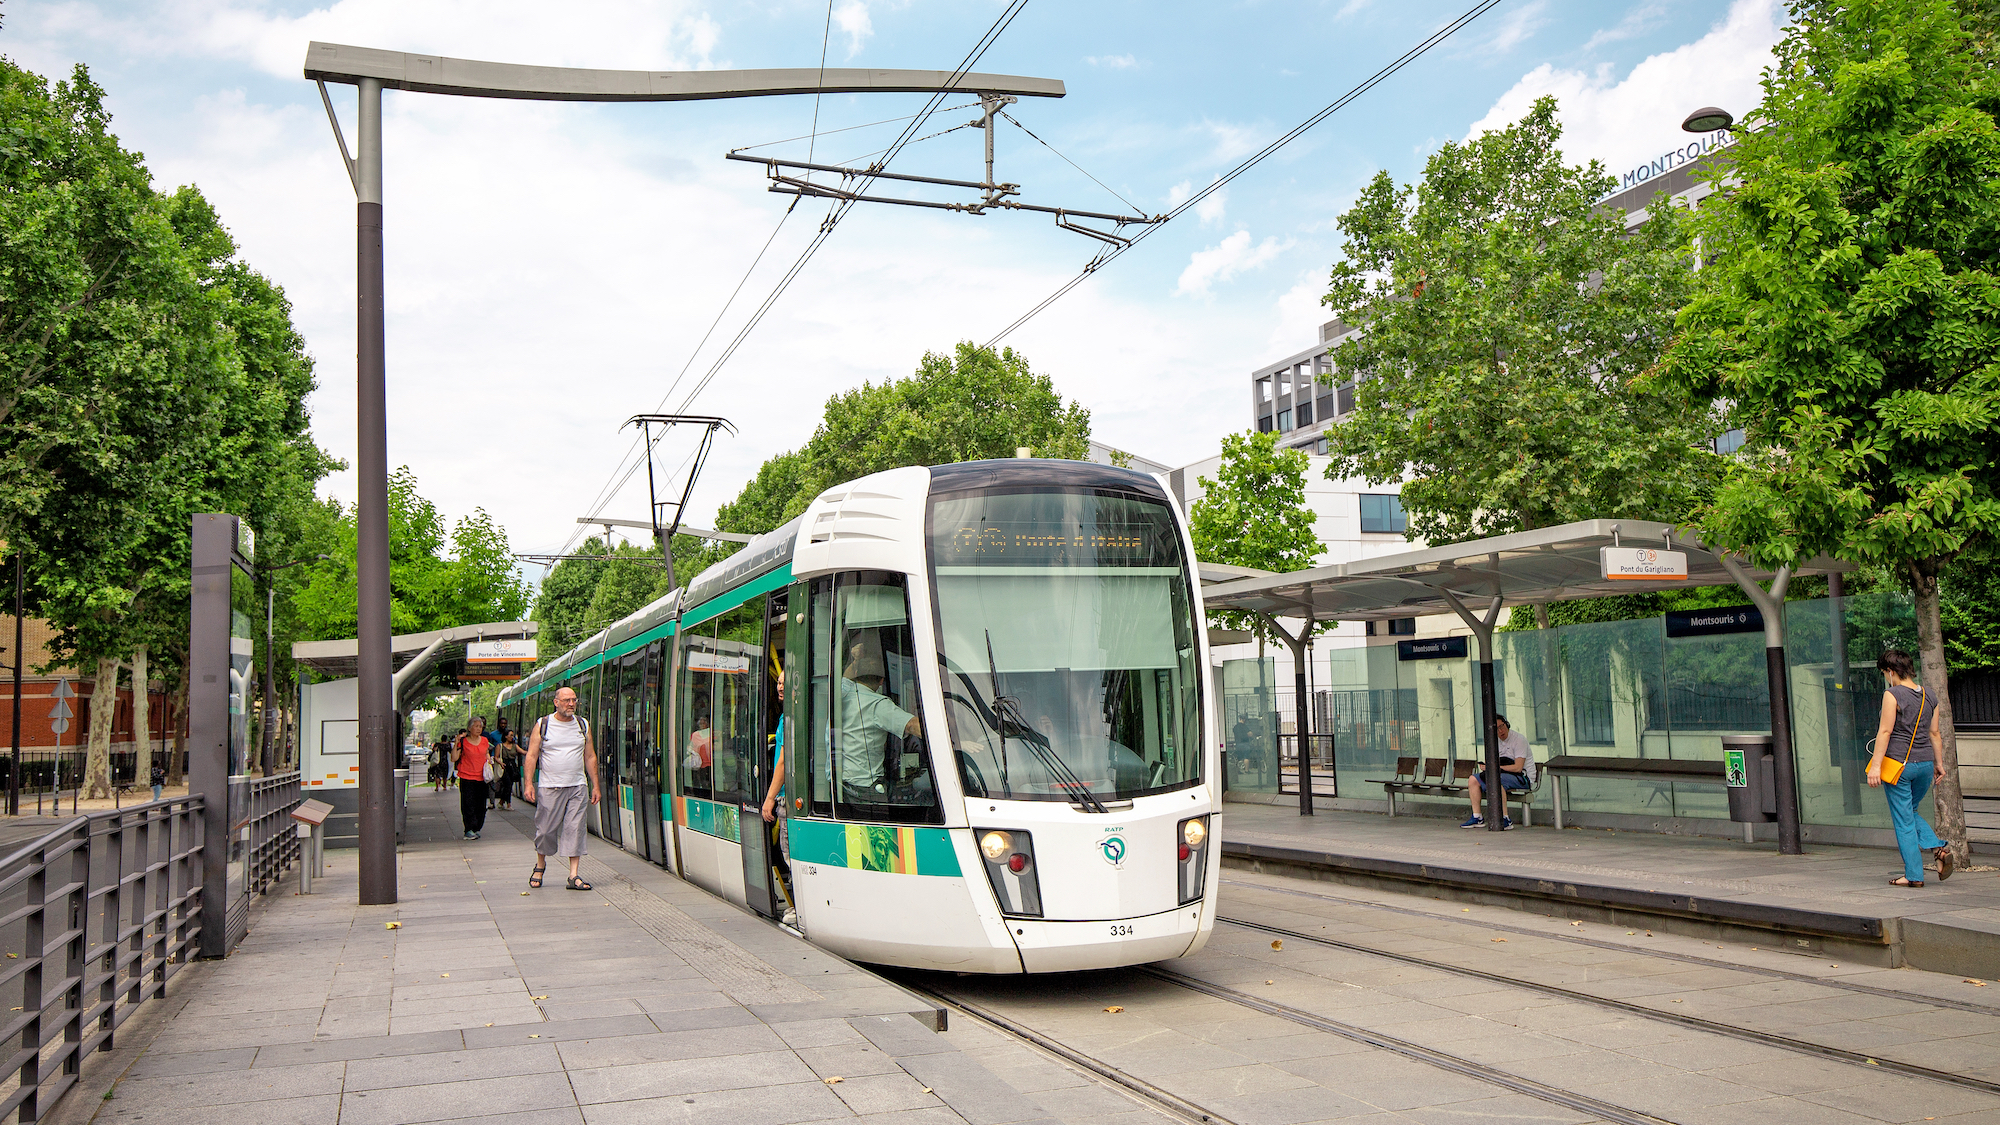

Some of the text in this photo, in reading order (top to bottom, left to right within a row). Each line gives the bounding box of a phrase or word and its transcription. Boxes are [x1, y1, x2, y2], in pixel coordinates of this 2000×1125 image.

[1620, 565, 1675, 574] Pont du Garigliano
[1690, 614, 1735, 627] Montsouris
[1110, 924, 1134, 936] 334
